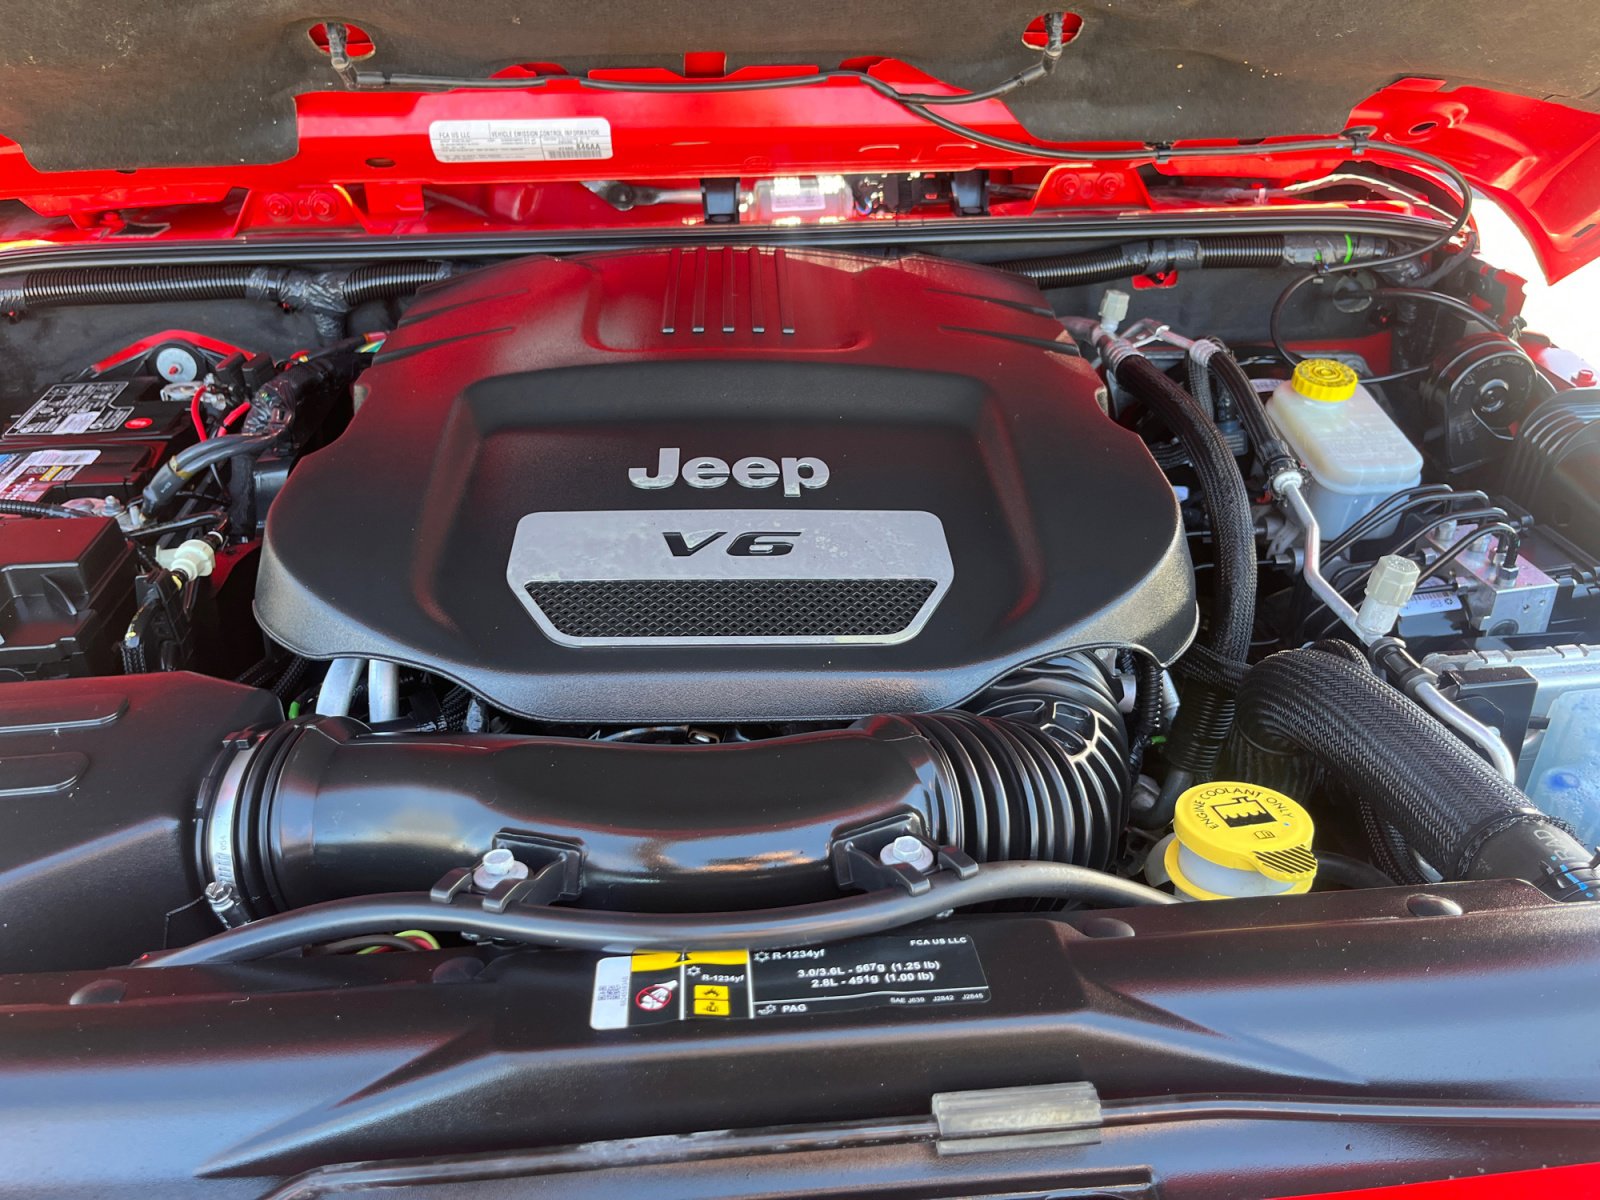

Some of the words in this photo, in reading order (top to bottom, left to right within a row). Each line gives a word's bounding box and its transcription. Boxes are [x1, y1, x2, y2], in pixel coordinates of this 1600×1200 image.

[628, 447, 829, 497] Jeep
[662, 531, 802, 557] V6
[1200, 787, 1263, 800] COOLANT
[1194, 800, 1219, 830] ENGINE
[1266, 796, 1294, 819] ONLY
[910, 938, 930, 947] FCA
[948, 936, 968, 944] LLC
[771, 948, 825, 960] R-1234yf
[796, 966, 846, 979] 3.0/3.6L
[855, 962, 886, 975] 567g
[891, 961, 921, 972] (1.25
[923, 960, 941, 970] lb)
[700, 973, 745, 984] R-1234yf
[810, 978, 839, 989] 2.8L
[847, 974, 880, 985] 451g
[884, 972, 915, 983] (1.00
[917, 971, 935, 982] lb)
[781, 1003, 808, 1013] PAG
[889, 996, 905, 1005] SAE
[907, 996, 926, 1005] J639
